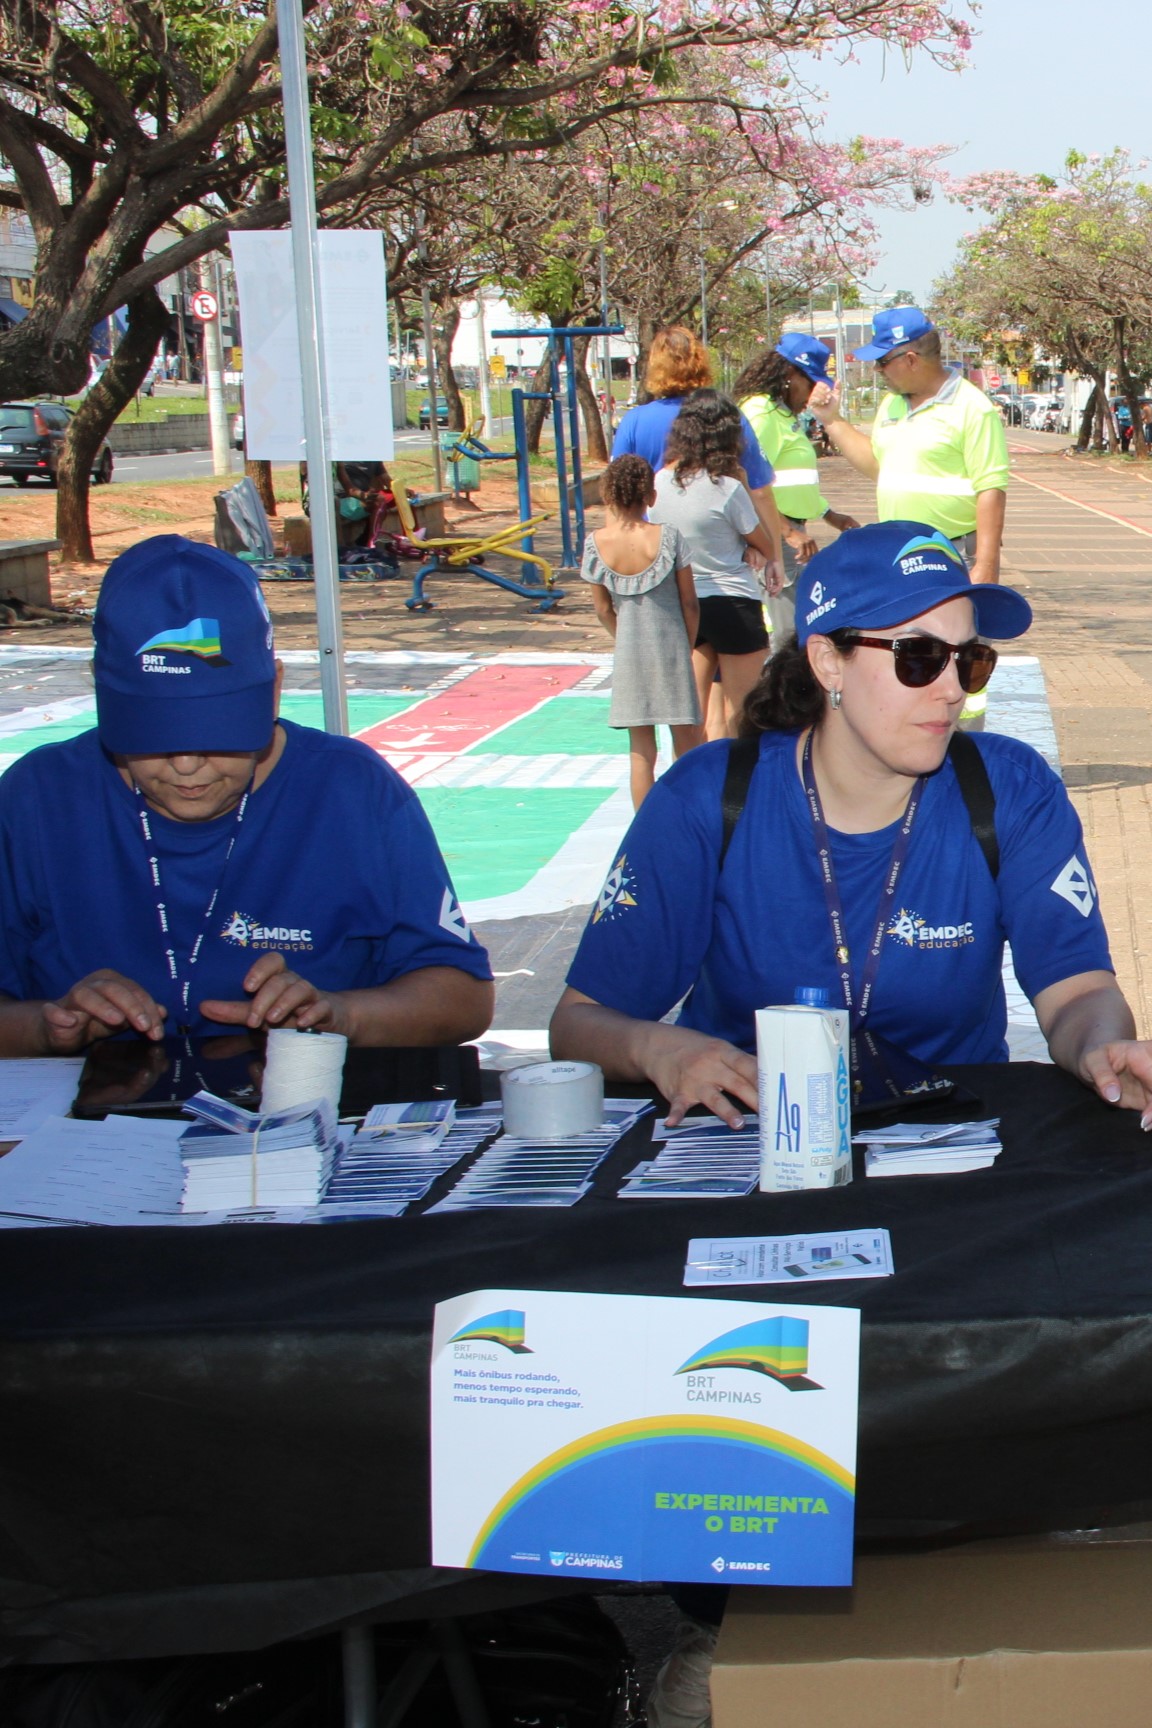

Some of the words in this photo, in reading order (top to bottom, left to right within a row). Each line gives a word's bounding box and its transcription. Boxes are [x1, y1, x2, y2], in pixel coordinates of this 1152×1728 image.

[201, 297, 211, 314] E
[900, 556, 924, 569] BRT
[902, 564, 948, 576] CAMPINAS
[806, 598, 837, 626] EMDEC
[142, 655, 166, 665] BRT
[142, 665, 191, 674] CAMPINAS
[810, 796, 820, 821] EMDEC
[905, 802, 917, 826] EMDEC
[143, 818, 151, 840] EMDEC
[152, 864, 160, 886] EMDEC
[822, 857, 832, 883] EMDEC
[890, 862, 900, 887] EMDEC
[160, 910, 168, 932] EMDEC
[252, 927, 313, 942] EMDEC
[833, 919, 843, 945] EMDEC
[875, 922, 885, 948] EMDEC
[918, 922, 974, 941] EMDEC
[252, 941, 314, 952] educação
[169, 956, 177, 979] EMDEC
[843, 980, 852, 1006] EMDEC
[862, 984, 871, 1009] EMDEC
[836, 1045, 849, 1157] ÁGUA
[453, 1344, 471, 1352] BRT
[453, 1352, 498, 1362] CAMPINAS
[454, 1369, 477, 1378] Mais
[479, 1370, 512, 1380] ônibus
[514, 1372, 561, 1383] rodando,
[687, 1376, 715, 1388] BRT
[453, 1383, 487, 1391] menos
[489, 1384, 523, 1394] tempo
[525, 1387, 581, 1398] esperando,
[686, 1390, 762, 1404] CAMPINAS
[453, 1395, 478, 1404] mais
[479, 1396, 525, 1408] tranquilo
[527, 1399, 544, 1408] pra
[546, 1399, 584, 1410] chegar.
[655, 1492, 830, 1515] EXPERIMENTA
[705, 1516, 724, 1533] O
[730, 1517, 778, 1534] BRT
[565, 1552, 610, 1560] PREFEITURA
[565, 1557, 623, 1569] CAMPINAS
[729, 1561, 771, 1571] EMDEC
